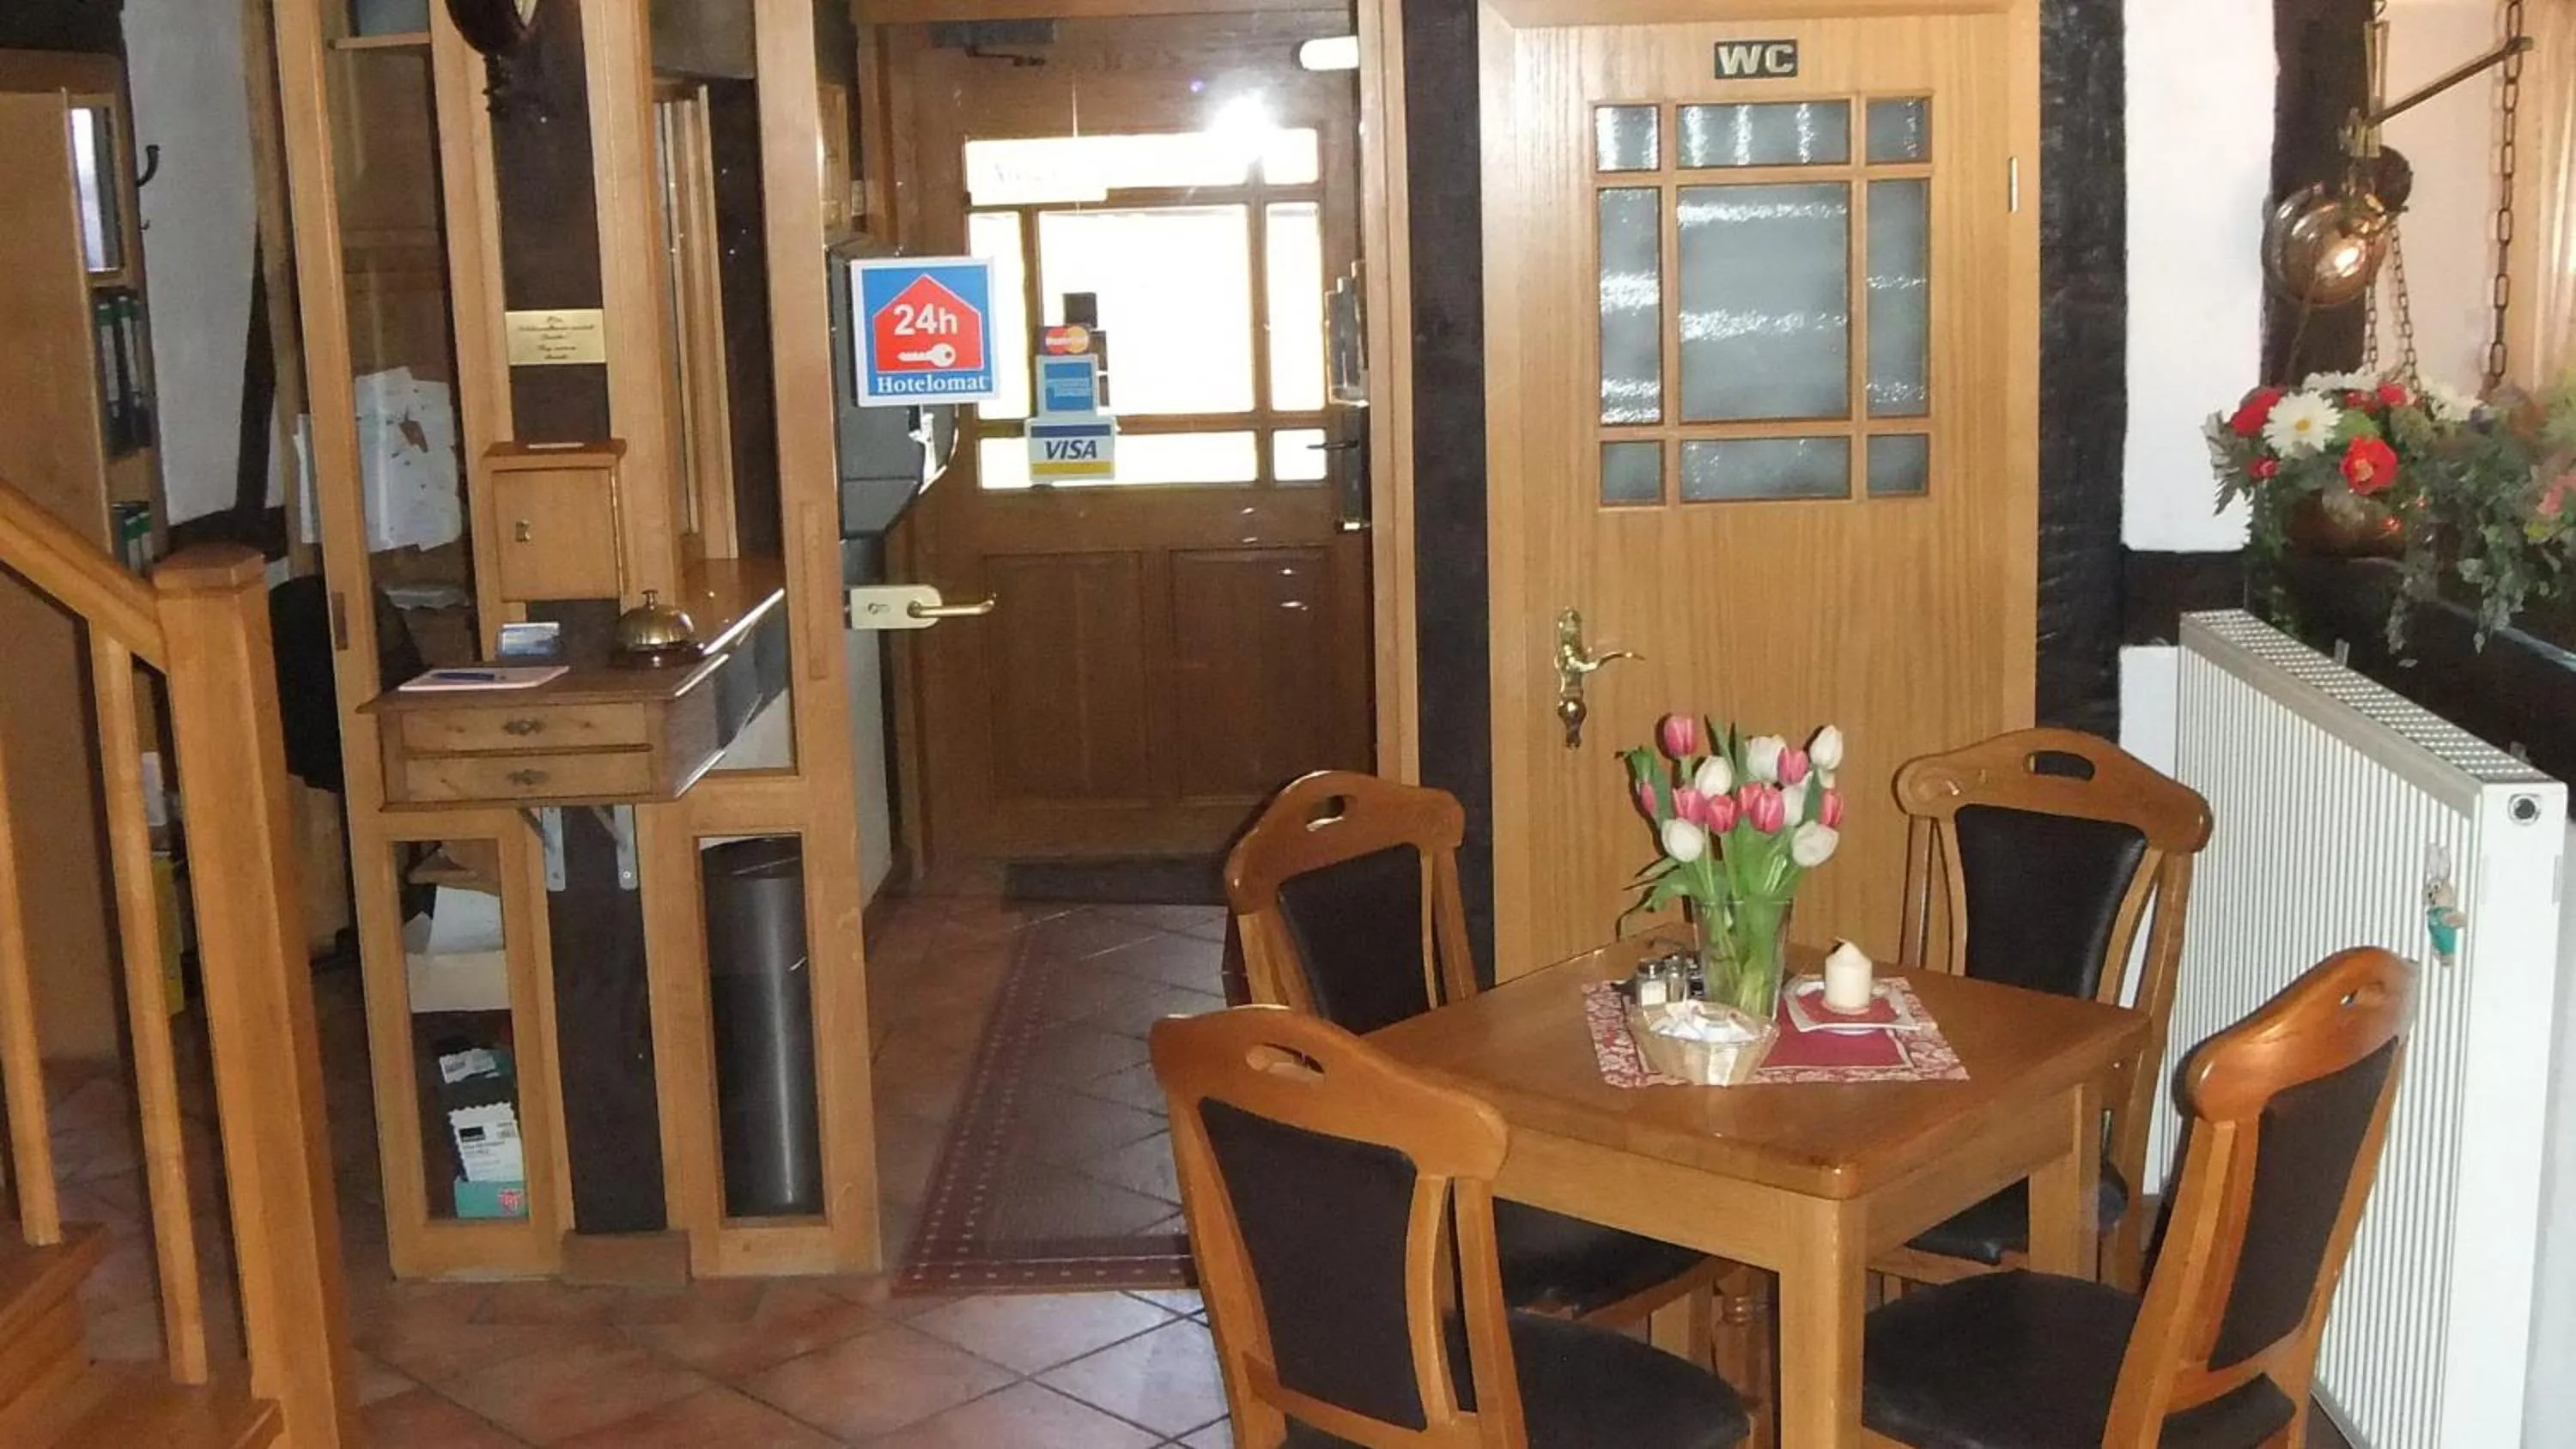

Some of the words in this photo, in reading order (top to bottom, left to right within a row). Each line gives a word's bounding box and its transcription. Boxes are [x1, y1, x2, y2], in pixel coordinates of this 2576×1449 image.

[1718, 44, 1794, 75] WC
[893, 303, 958, 336] 24h
[876, 373, 989, 394] Hotelomat
[1045, 439, 1097, 459] VISA
